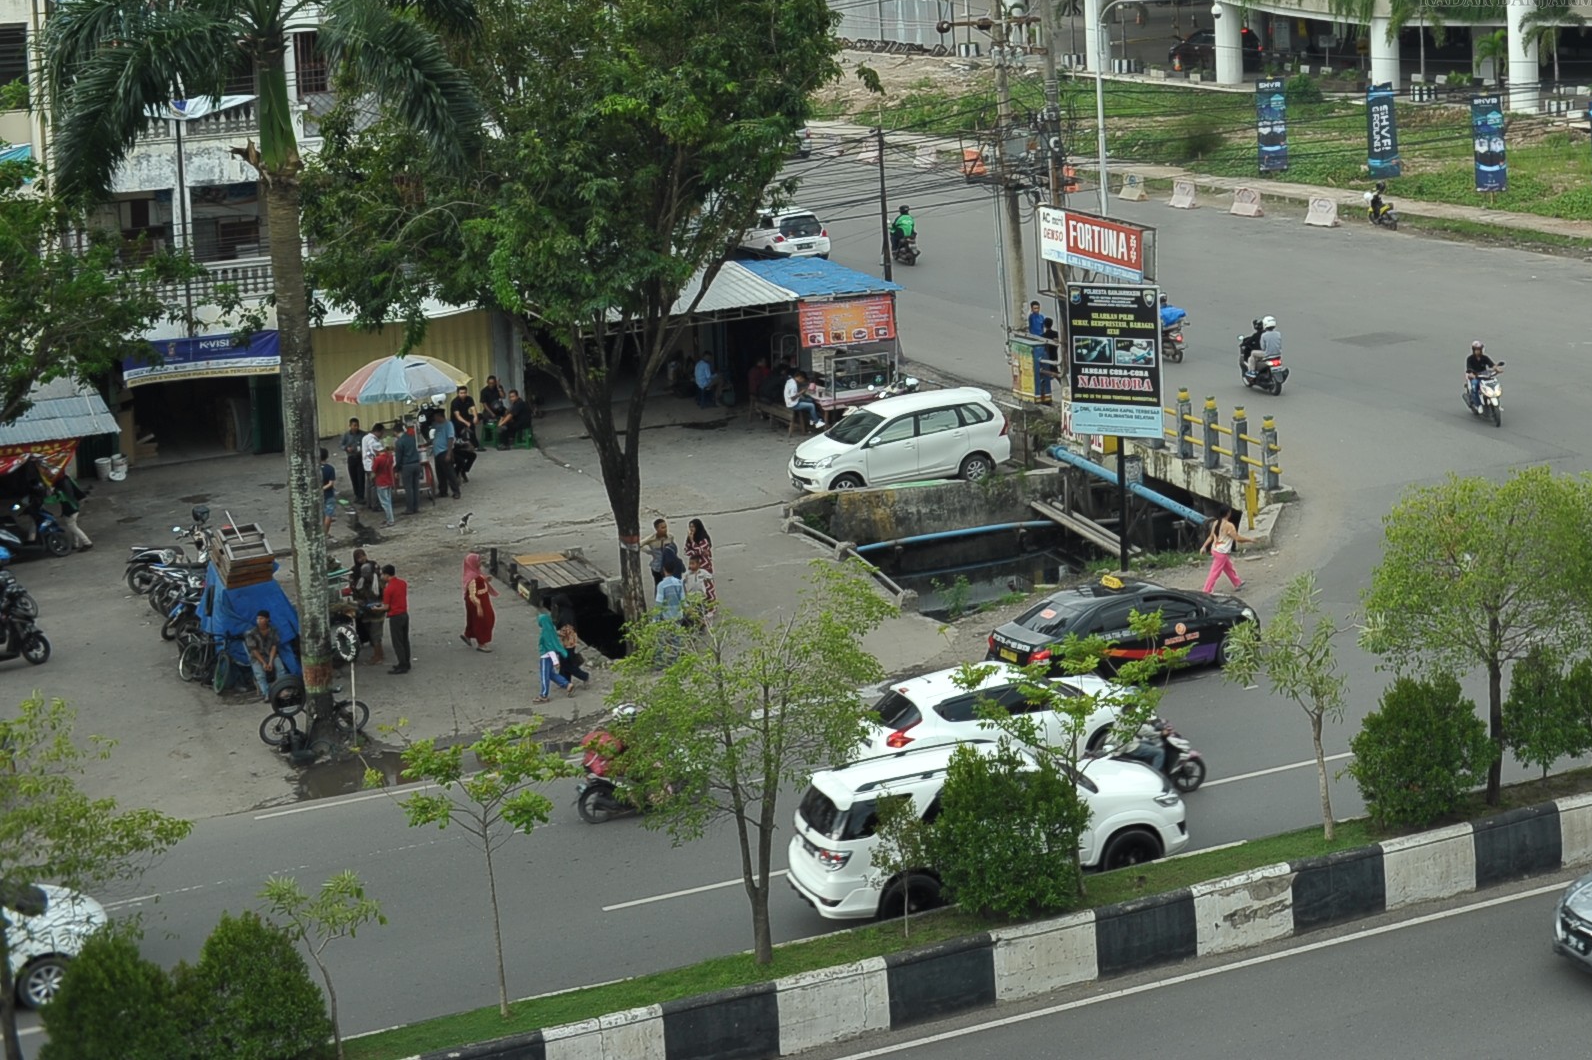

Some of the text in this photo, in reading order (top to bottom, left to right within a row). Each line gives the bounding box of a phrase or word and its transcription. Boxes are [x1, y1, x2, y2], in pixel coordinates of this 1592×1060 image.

[1042, 211, 1051, 224] AC
[1044, 227, 1064, 243] DENSO
[1069, 219, 1128, 261] FORTUNA
[1081, 367, 1149, 377] JANGAN COBA-COBA
[1077, 375, 1153, 392] NARKOBA
